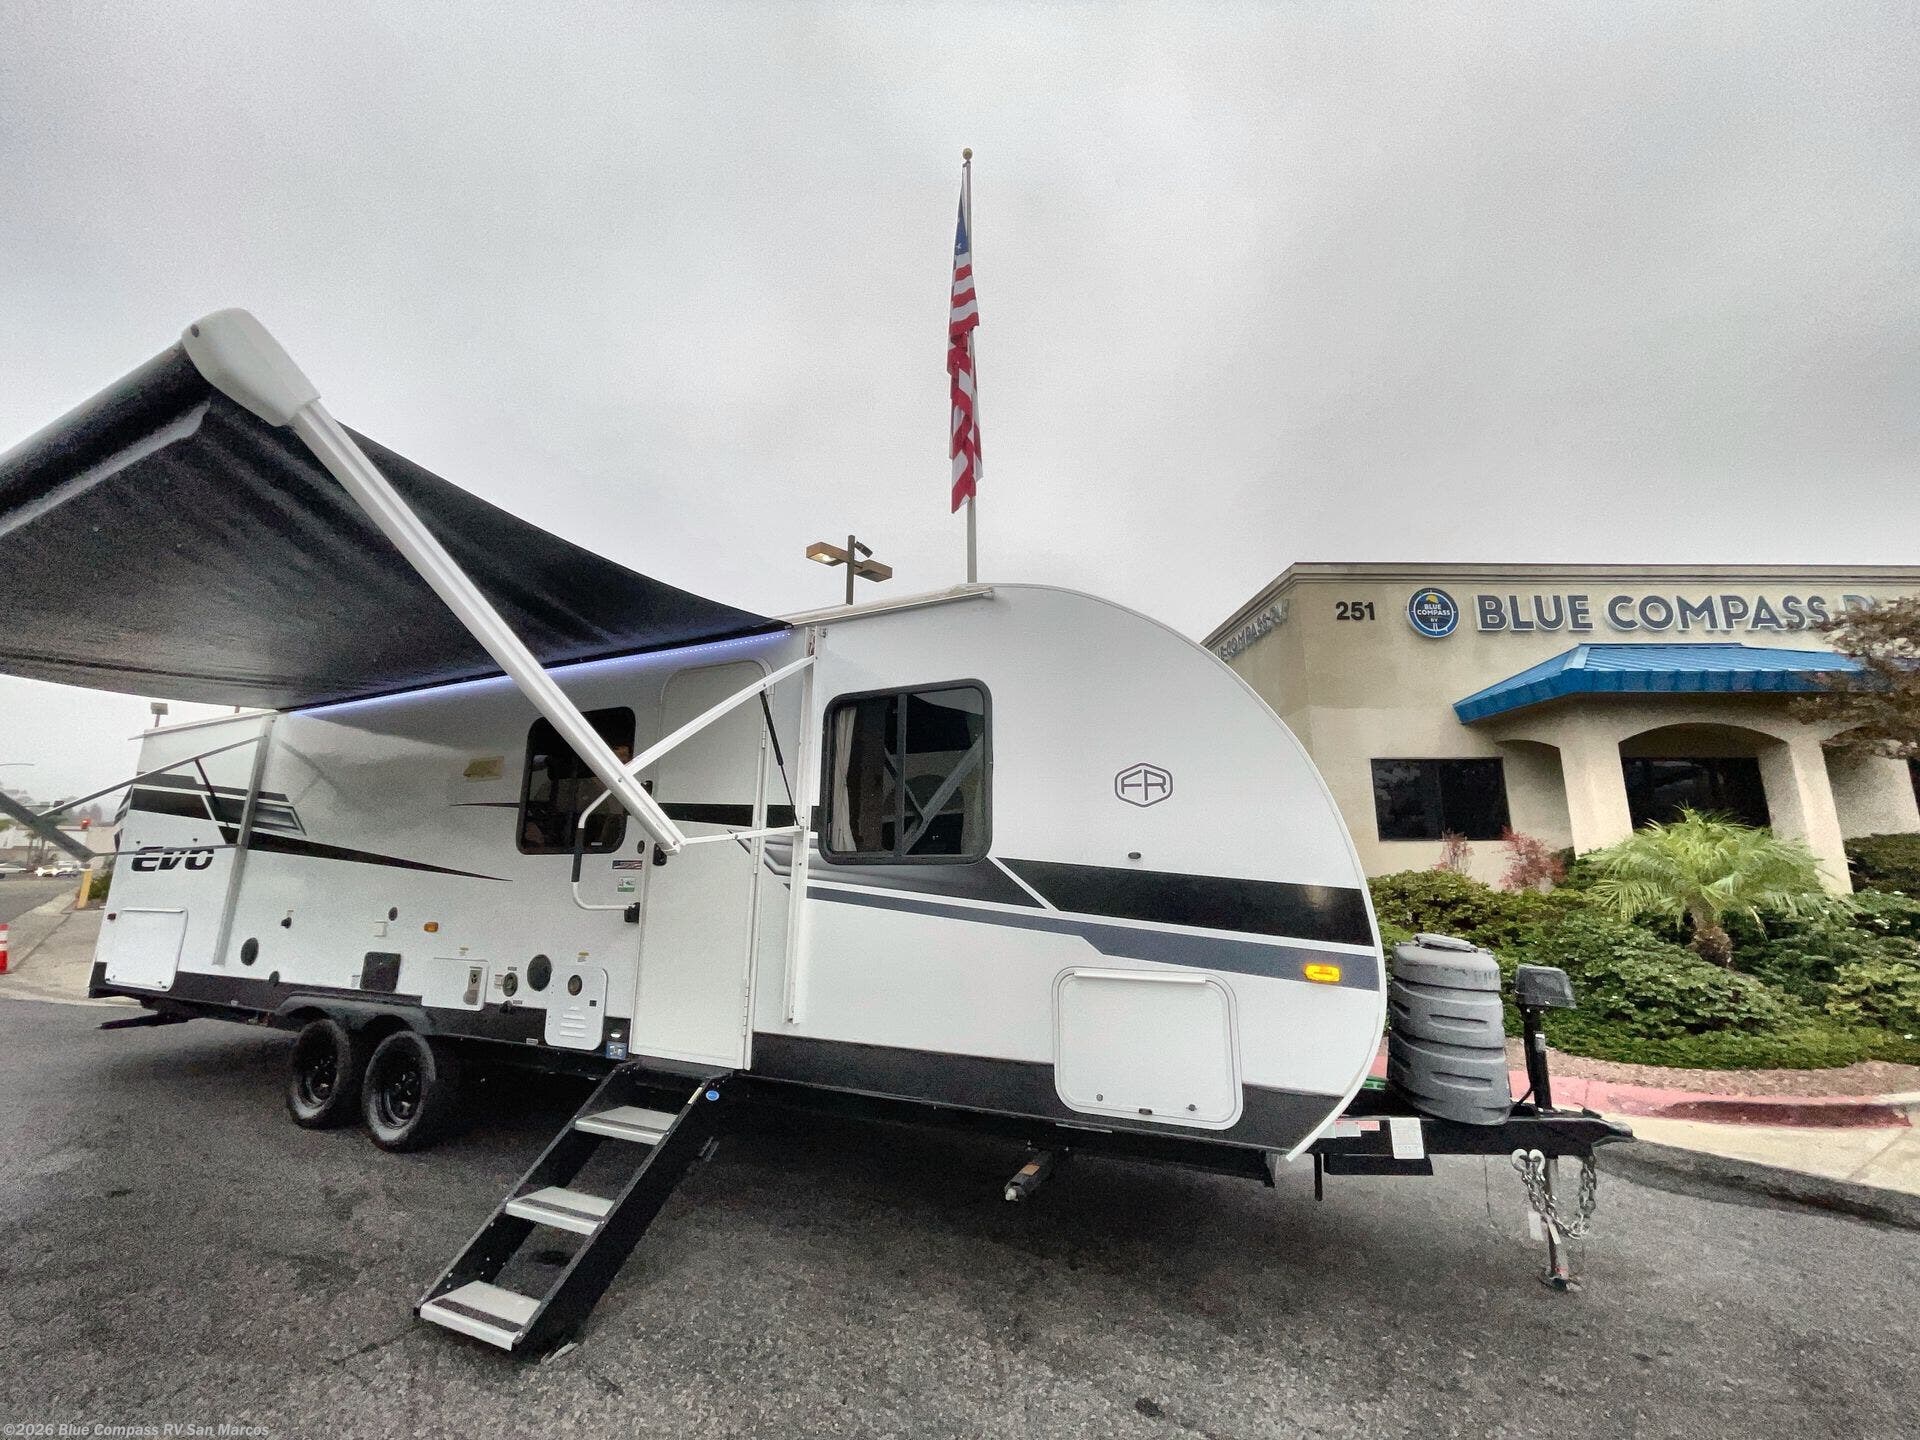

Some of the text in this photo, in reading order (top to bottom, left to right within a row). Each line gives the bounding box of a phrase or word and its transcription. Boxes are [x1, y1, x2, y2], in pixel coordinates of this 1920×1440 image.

[1335, 601, 1376, 621] 251
[1478, 594, 1591, 632] BLUE
[1607, 594, 1832, 632] COMPASS
[131, 846, 215, 872] EVO
